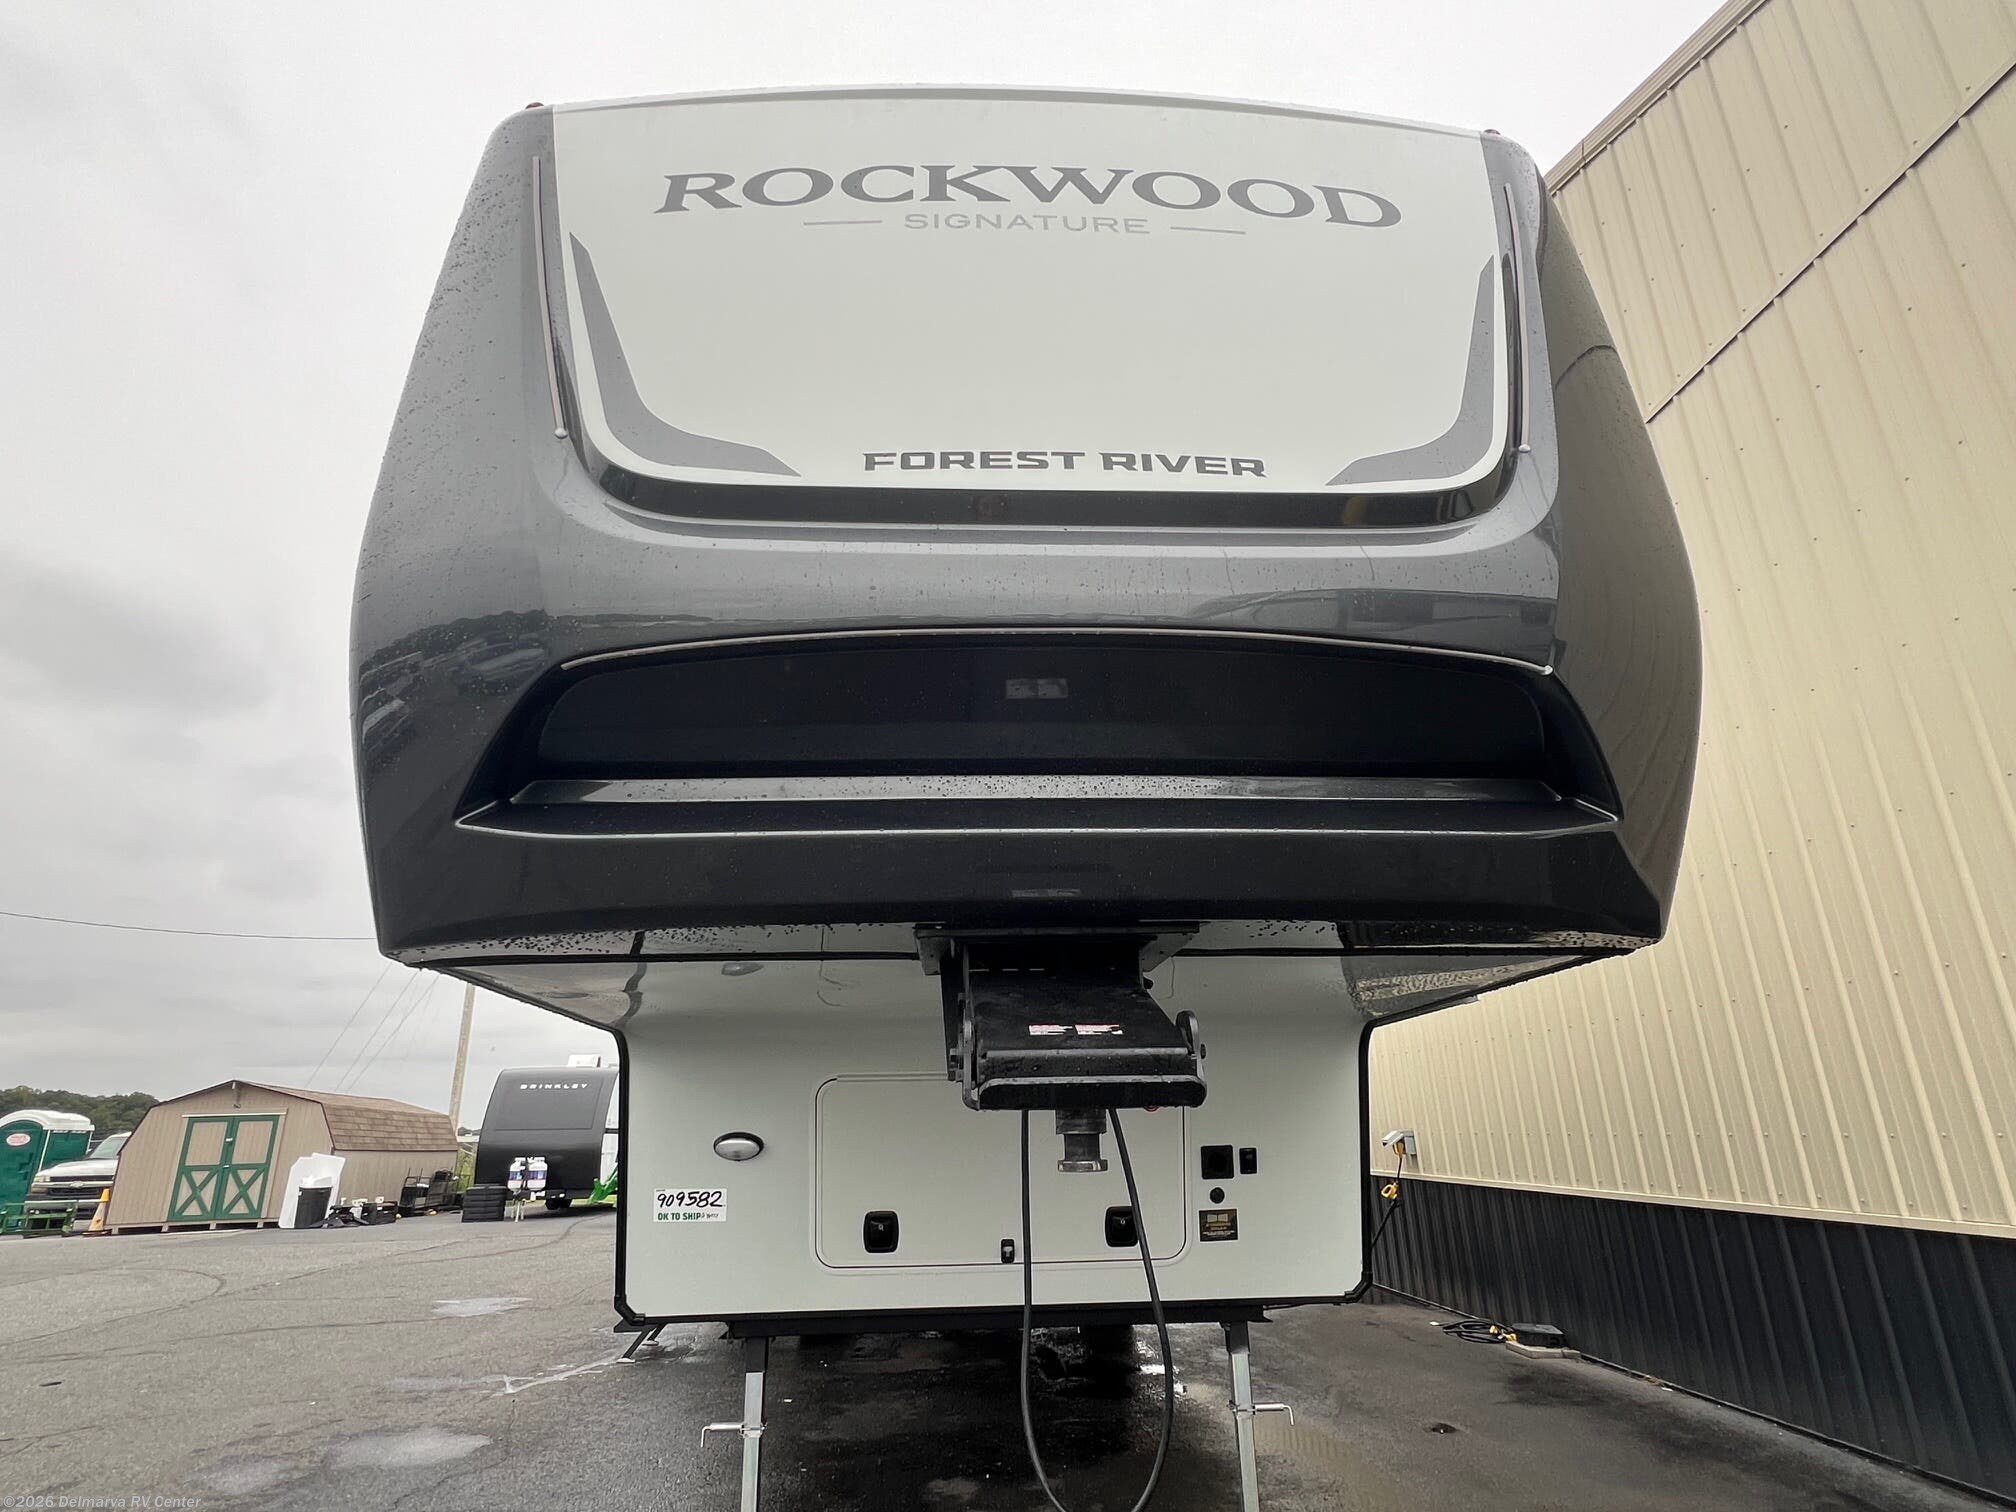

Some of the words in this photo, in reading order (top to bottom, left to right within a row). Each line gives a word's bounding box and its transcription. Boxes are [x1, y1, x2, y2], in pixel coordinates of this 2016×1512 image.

[653, 164, 1402, 228] ROCKWOOD
[904, 213, 1150, 234] SIGNATURE
[863, 451, 1085, 471] FOREST
[1098, 451, 1267, 478] RIVER
[657, 1191, 723, 1208] 909582
[657, 1212, 669, 1221] OK
[671, 1212, 681, 1221] TO
[682, 1212, 701, 1221] SHIP
